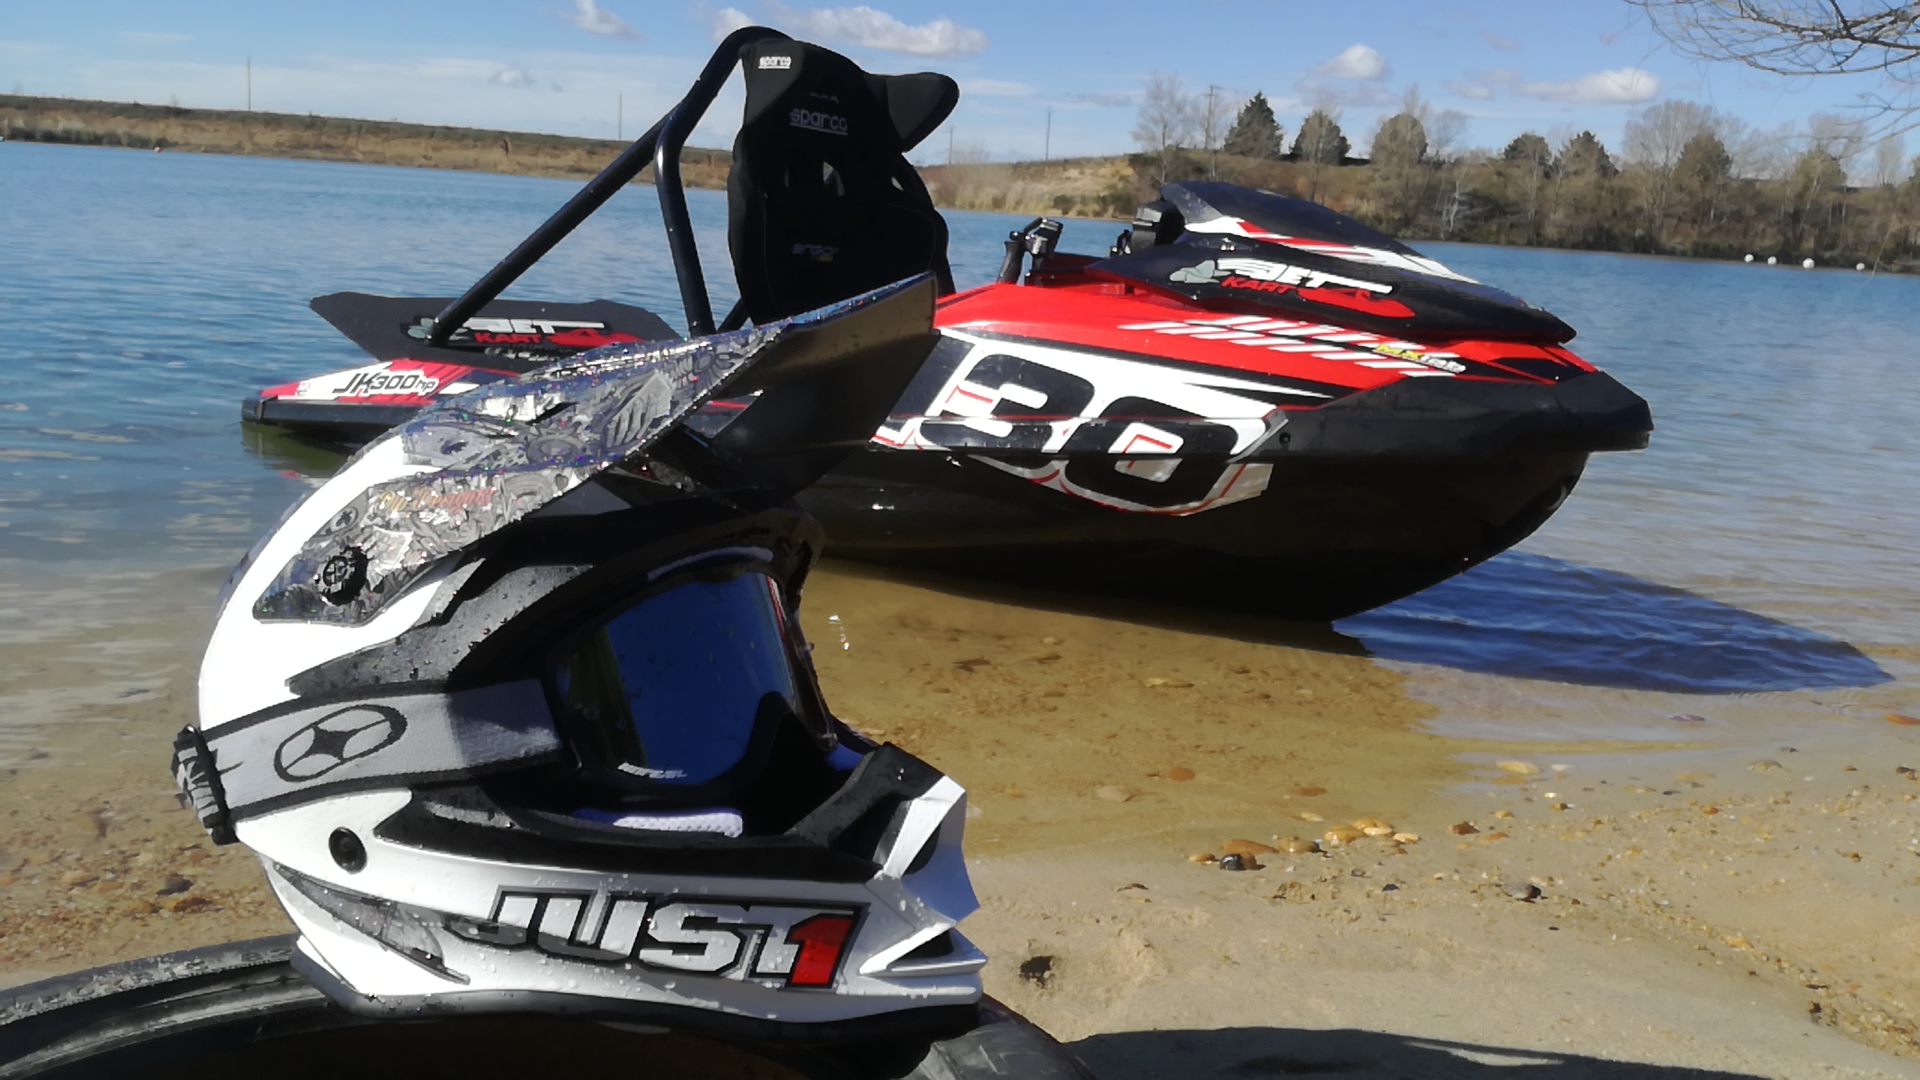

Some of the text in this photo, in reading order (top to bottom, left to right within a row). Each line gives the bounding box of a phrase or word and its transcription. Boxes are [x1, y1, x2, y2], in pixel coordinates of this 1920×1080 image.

[789, 108, 848, 135] sparco
[1220, 275, 1294, 295] KART
[474, 332, 543, 345] KART
